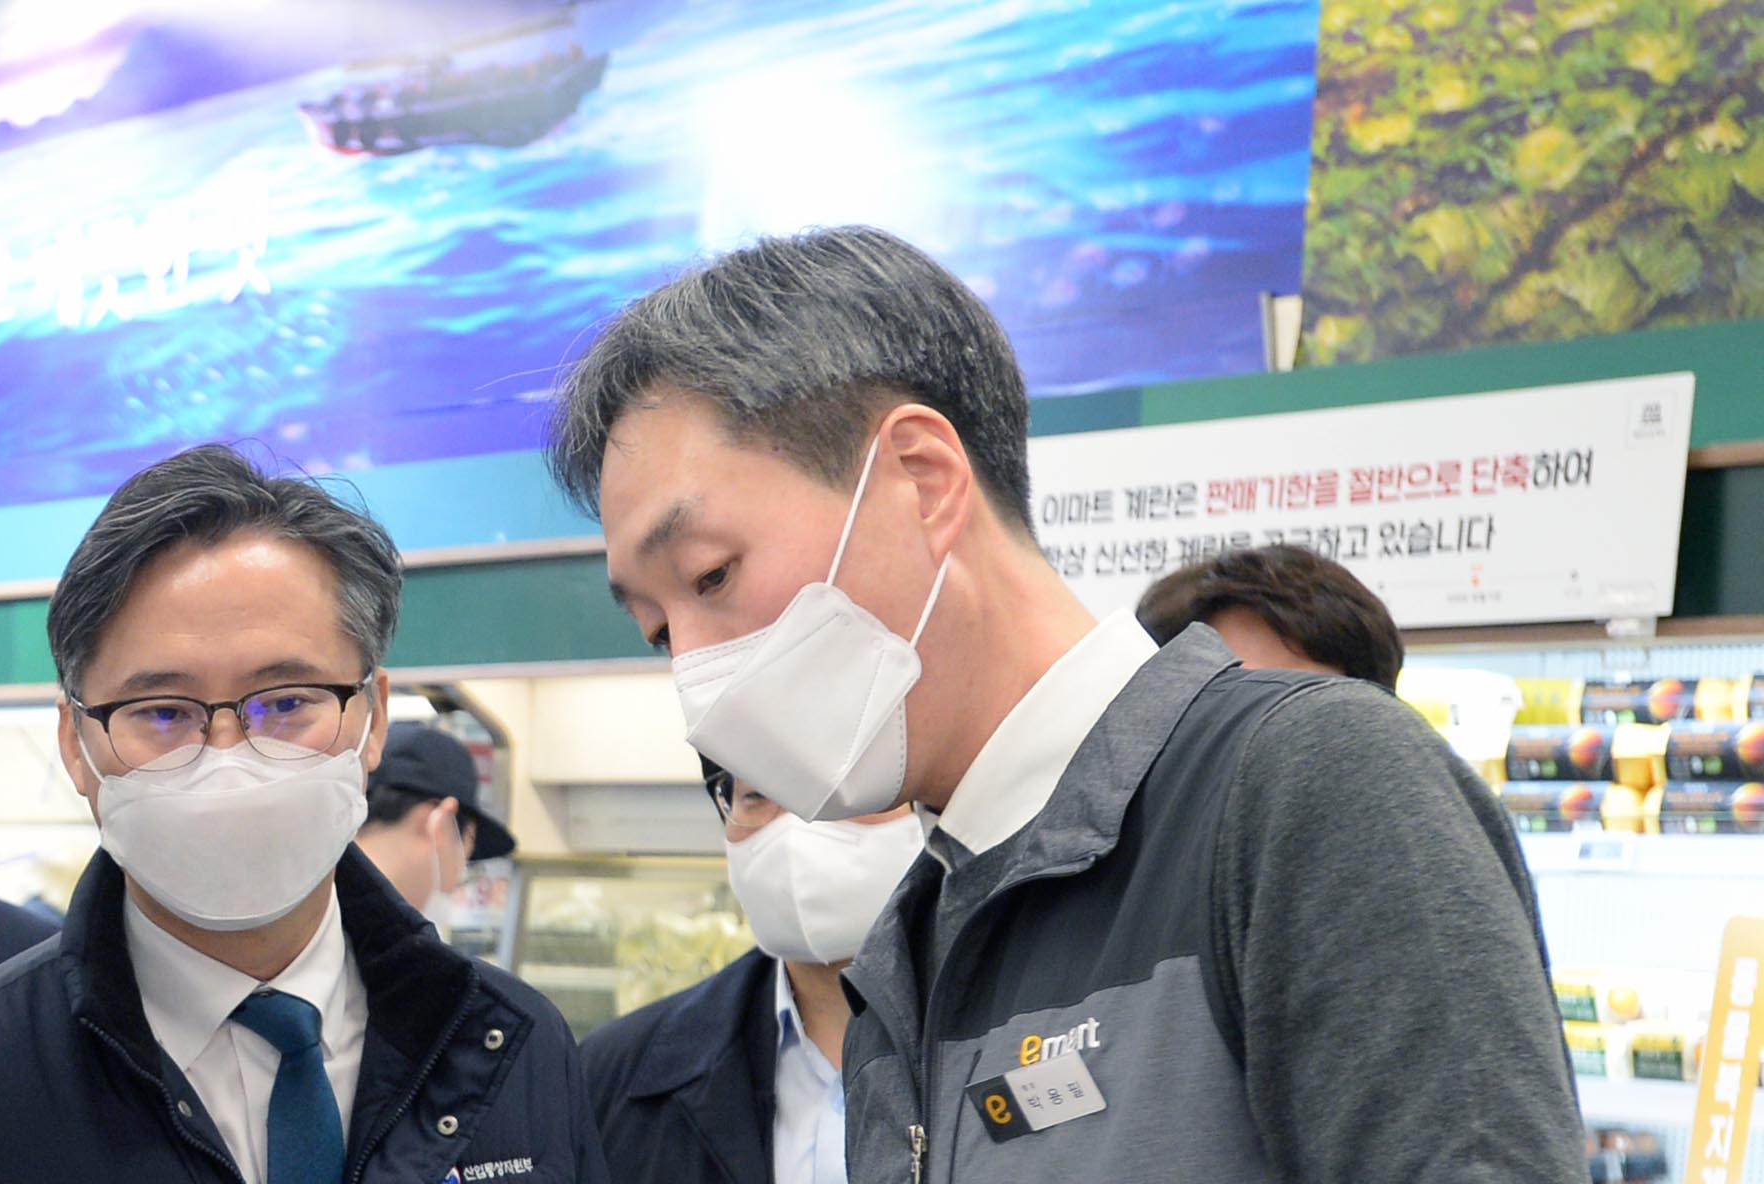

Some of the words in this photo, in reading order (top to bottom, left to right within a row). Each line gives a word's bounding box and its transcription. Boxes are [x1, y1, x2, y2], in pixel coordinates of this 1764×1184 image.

[1042, 489, 1114, 526] 이마트
[1124, 482, 1198, 520] 계란은
[1207, 470, 1339, 516] 판매기한을
[1348, 459, 1463, 505] 절반으로
[1471, 447, 1595, 495] 단축하여
[1094, 538, 1167, 575] 신선한
[1378, 512, 1497, 559] 있습니다
[462, 1157, 534, 1182] 산업통상자원부
